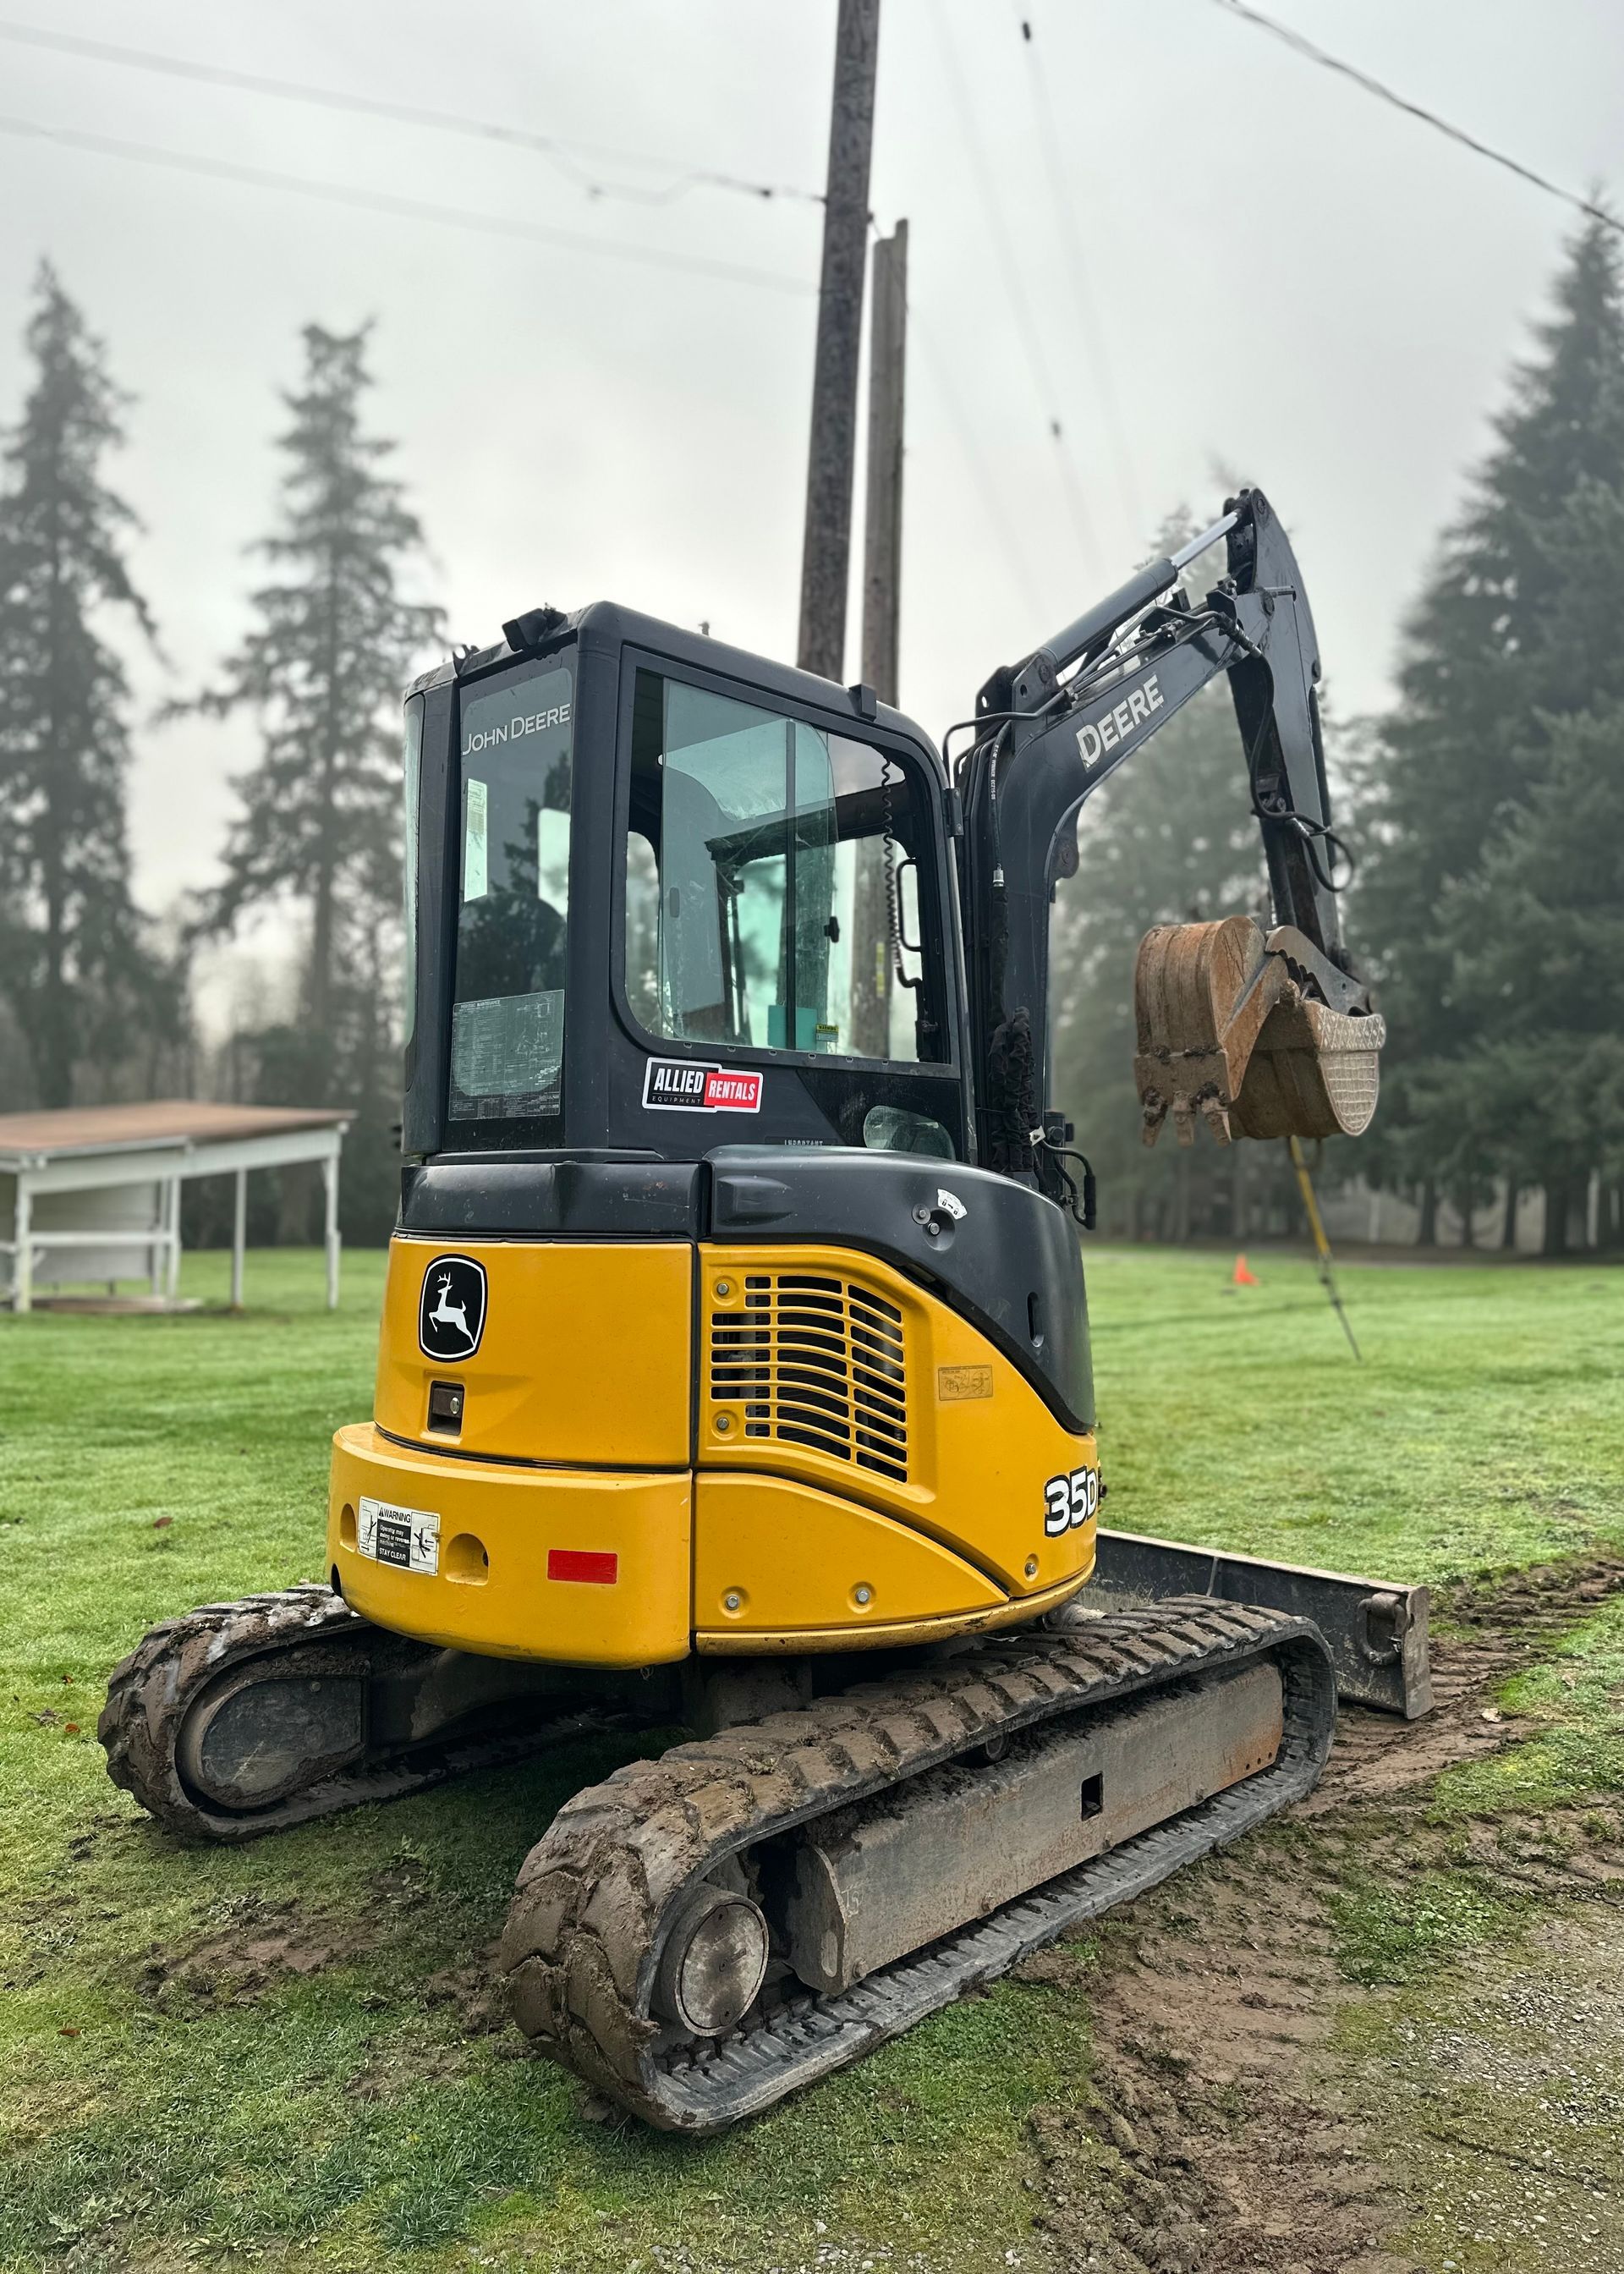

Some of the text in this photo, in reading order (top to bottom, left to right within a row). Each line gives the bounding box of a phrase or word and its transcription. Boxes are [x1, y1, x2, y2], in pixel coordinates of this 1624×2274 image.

[462, 703, 571, 755] JOHN DEERE
[1076, 674, 1165, 768] DEERE
[651, 1096, 701, 1104] EQUIPMENT
[653, 1068, 756, 1101] ALLIED RENTALS
[384, 1508, 411, 1523] WARNING
[1044, 1465, 1097, 1538] 35D
[379, 1547, 406, 1561] STAY CLEAR
